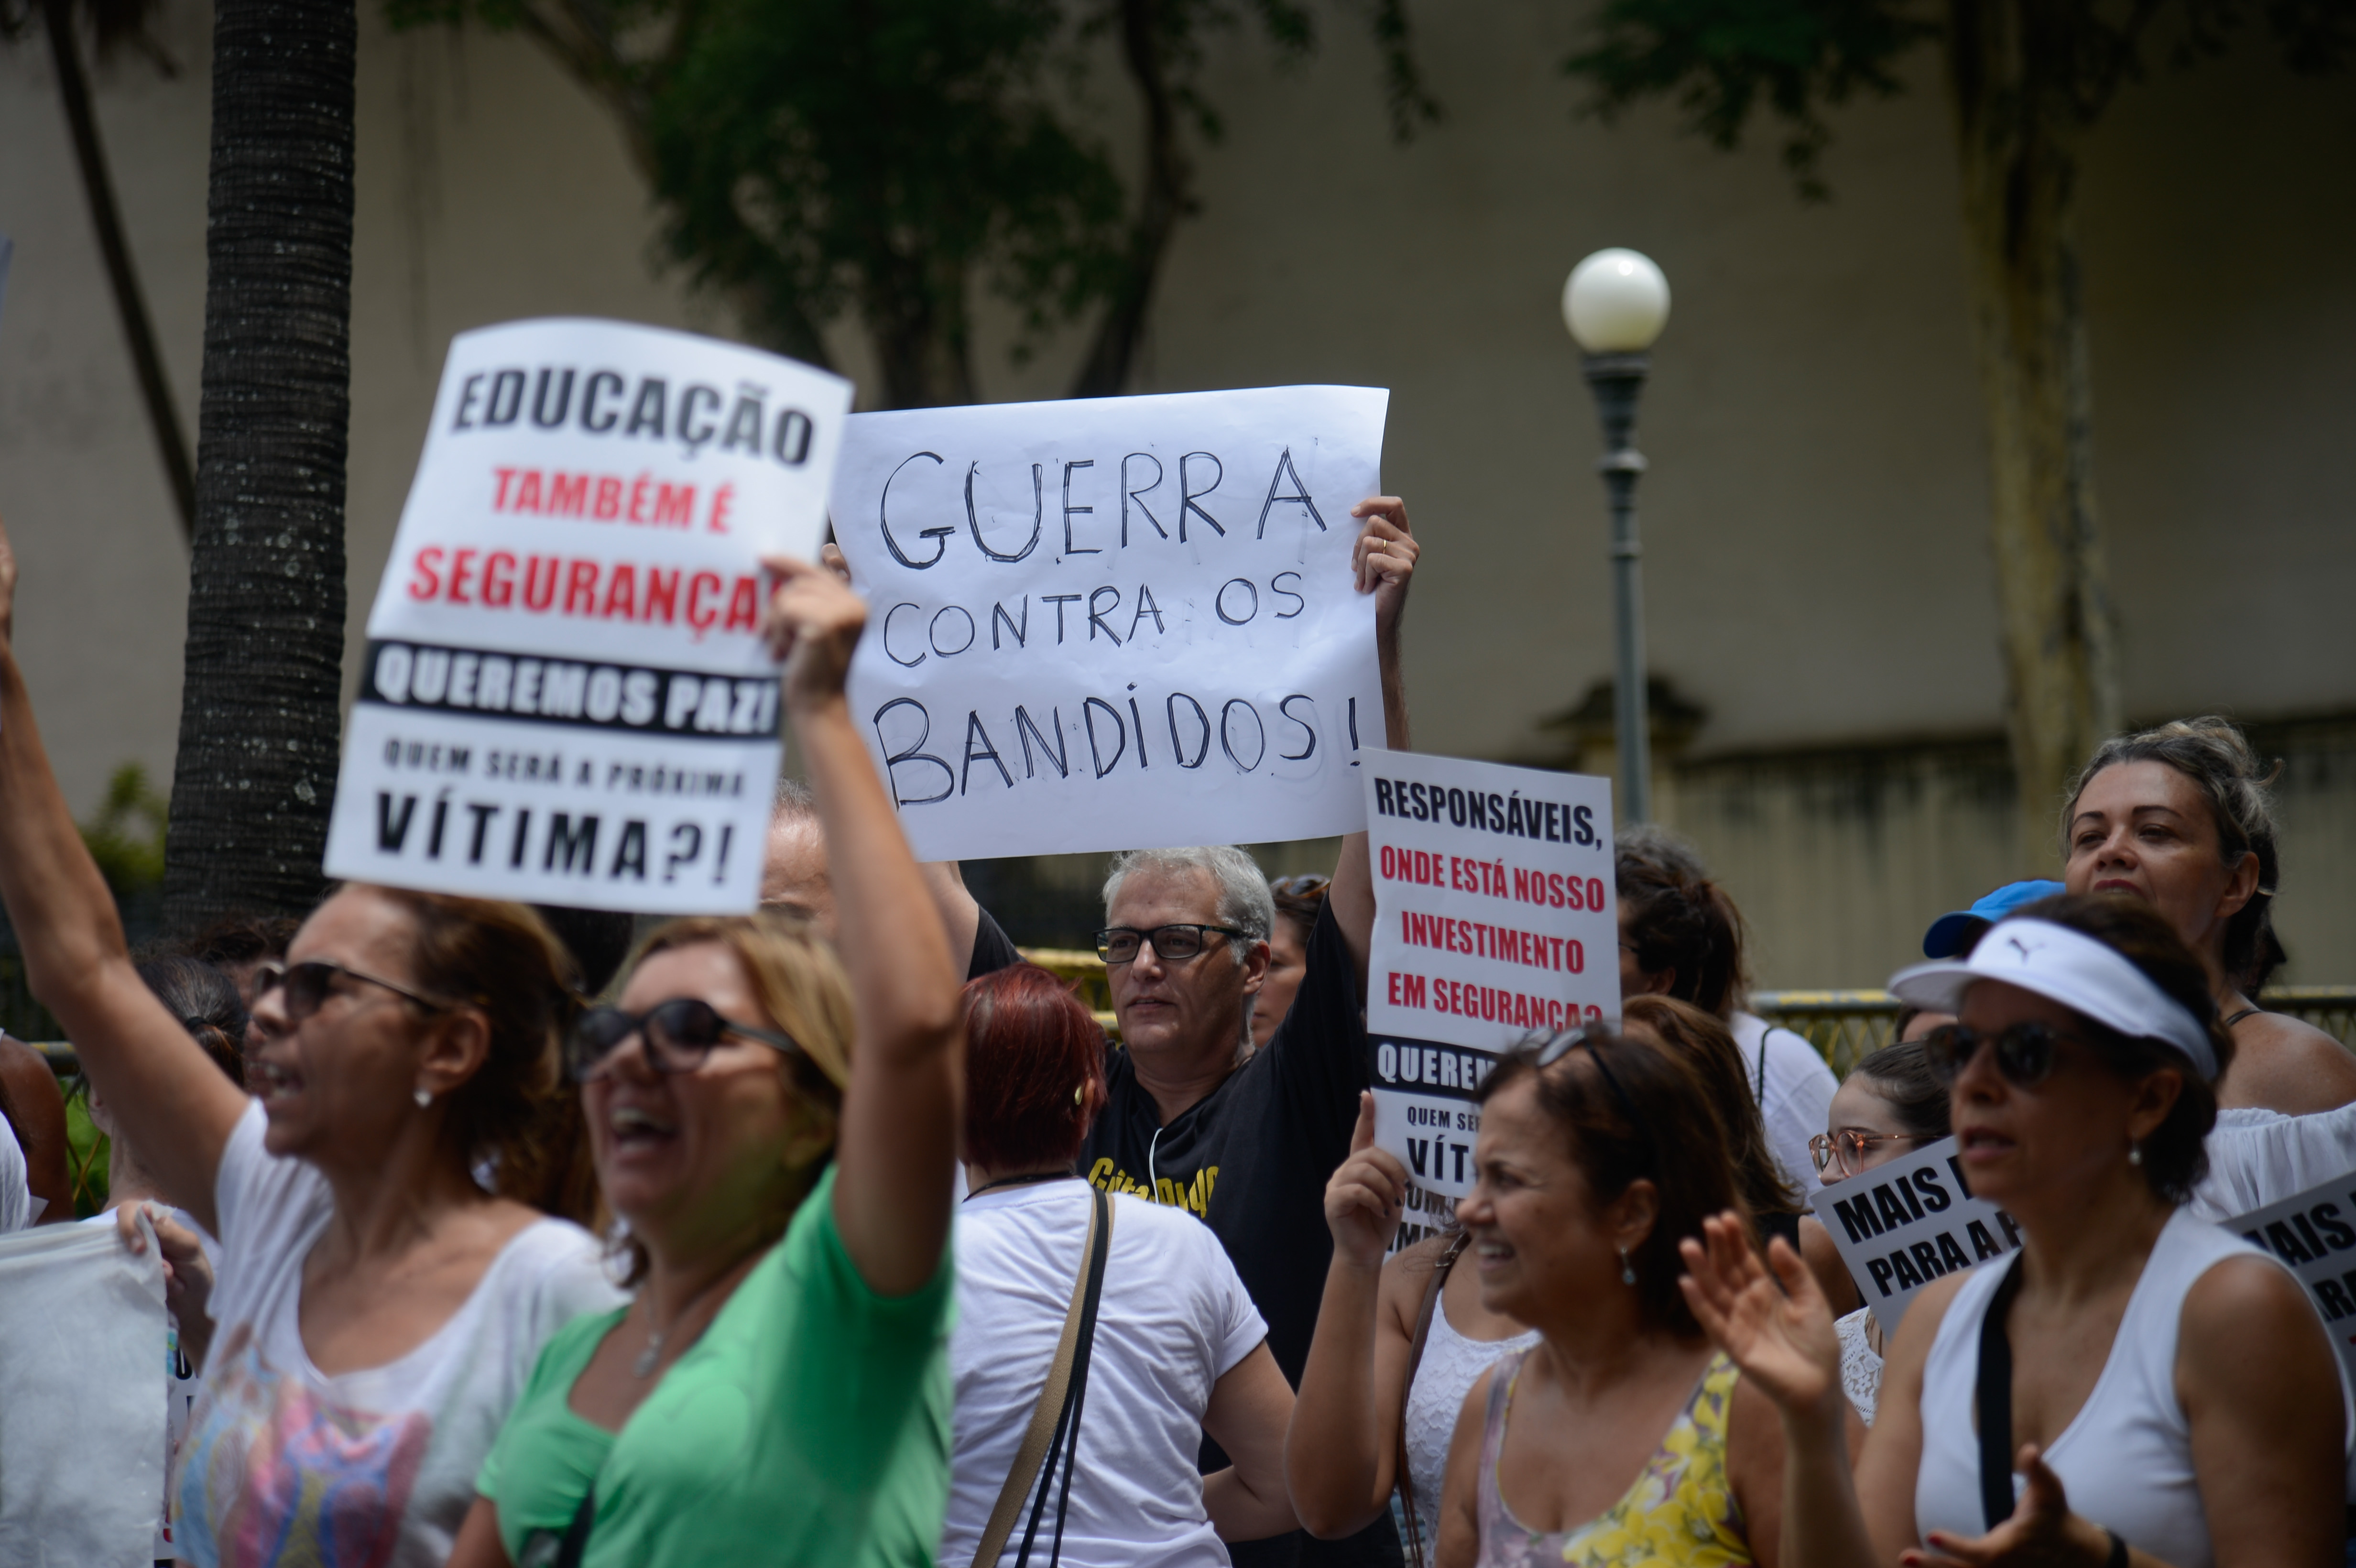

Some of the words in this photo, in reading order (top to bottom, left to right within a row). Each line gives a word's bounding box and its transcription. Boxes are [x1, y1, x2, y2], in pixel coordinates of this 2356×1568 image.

[450, 367, 814, 468] EDUCAÇÃO
[492, 467, 696, 531] TAMBÉM
[707, 478, 735, 533] É
[880, 445, 1327, 570] GUERRA
[407, 546, 779, 644] SEGURANÇA
[884, 583, 1165, 668] CONTRA
[1216, 571, 1305, 626] OS
[374, 643, 659, 725] QUEREMOS
[382, 738, 471, 773] QUEM
[484, 749, 559, 785] SERÁ
[575, 761, 595, 788] A
[608, 759, 744, 799] PRÓXIMA
[375, 783, 735, 884] VÍTIMA?!
[1374, 778, 1602, 851] RESPONSÁVEIS,
[1381, 845, 1445, 888] ONDE
[1451, 859, 1508, 899] ESTÁ
[1514, 868, 1604, 913] NOSSO
[1402, 911, 1584, 975] INVESTIMENTO
[1388, 972, 1426, 1009] EM
[1407, 1106, 1450, 1128] QUEM
[1407, 1134, 1469, 1183] VÍT
[1833, 1166, 1951, 1245] MAIS
[1866, 1231, 1972, 1298] PARA
[1965, 1219, 2002, 1262] A
